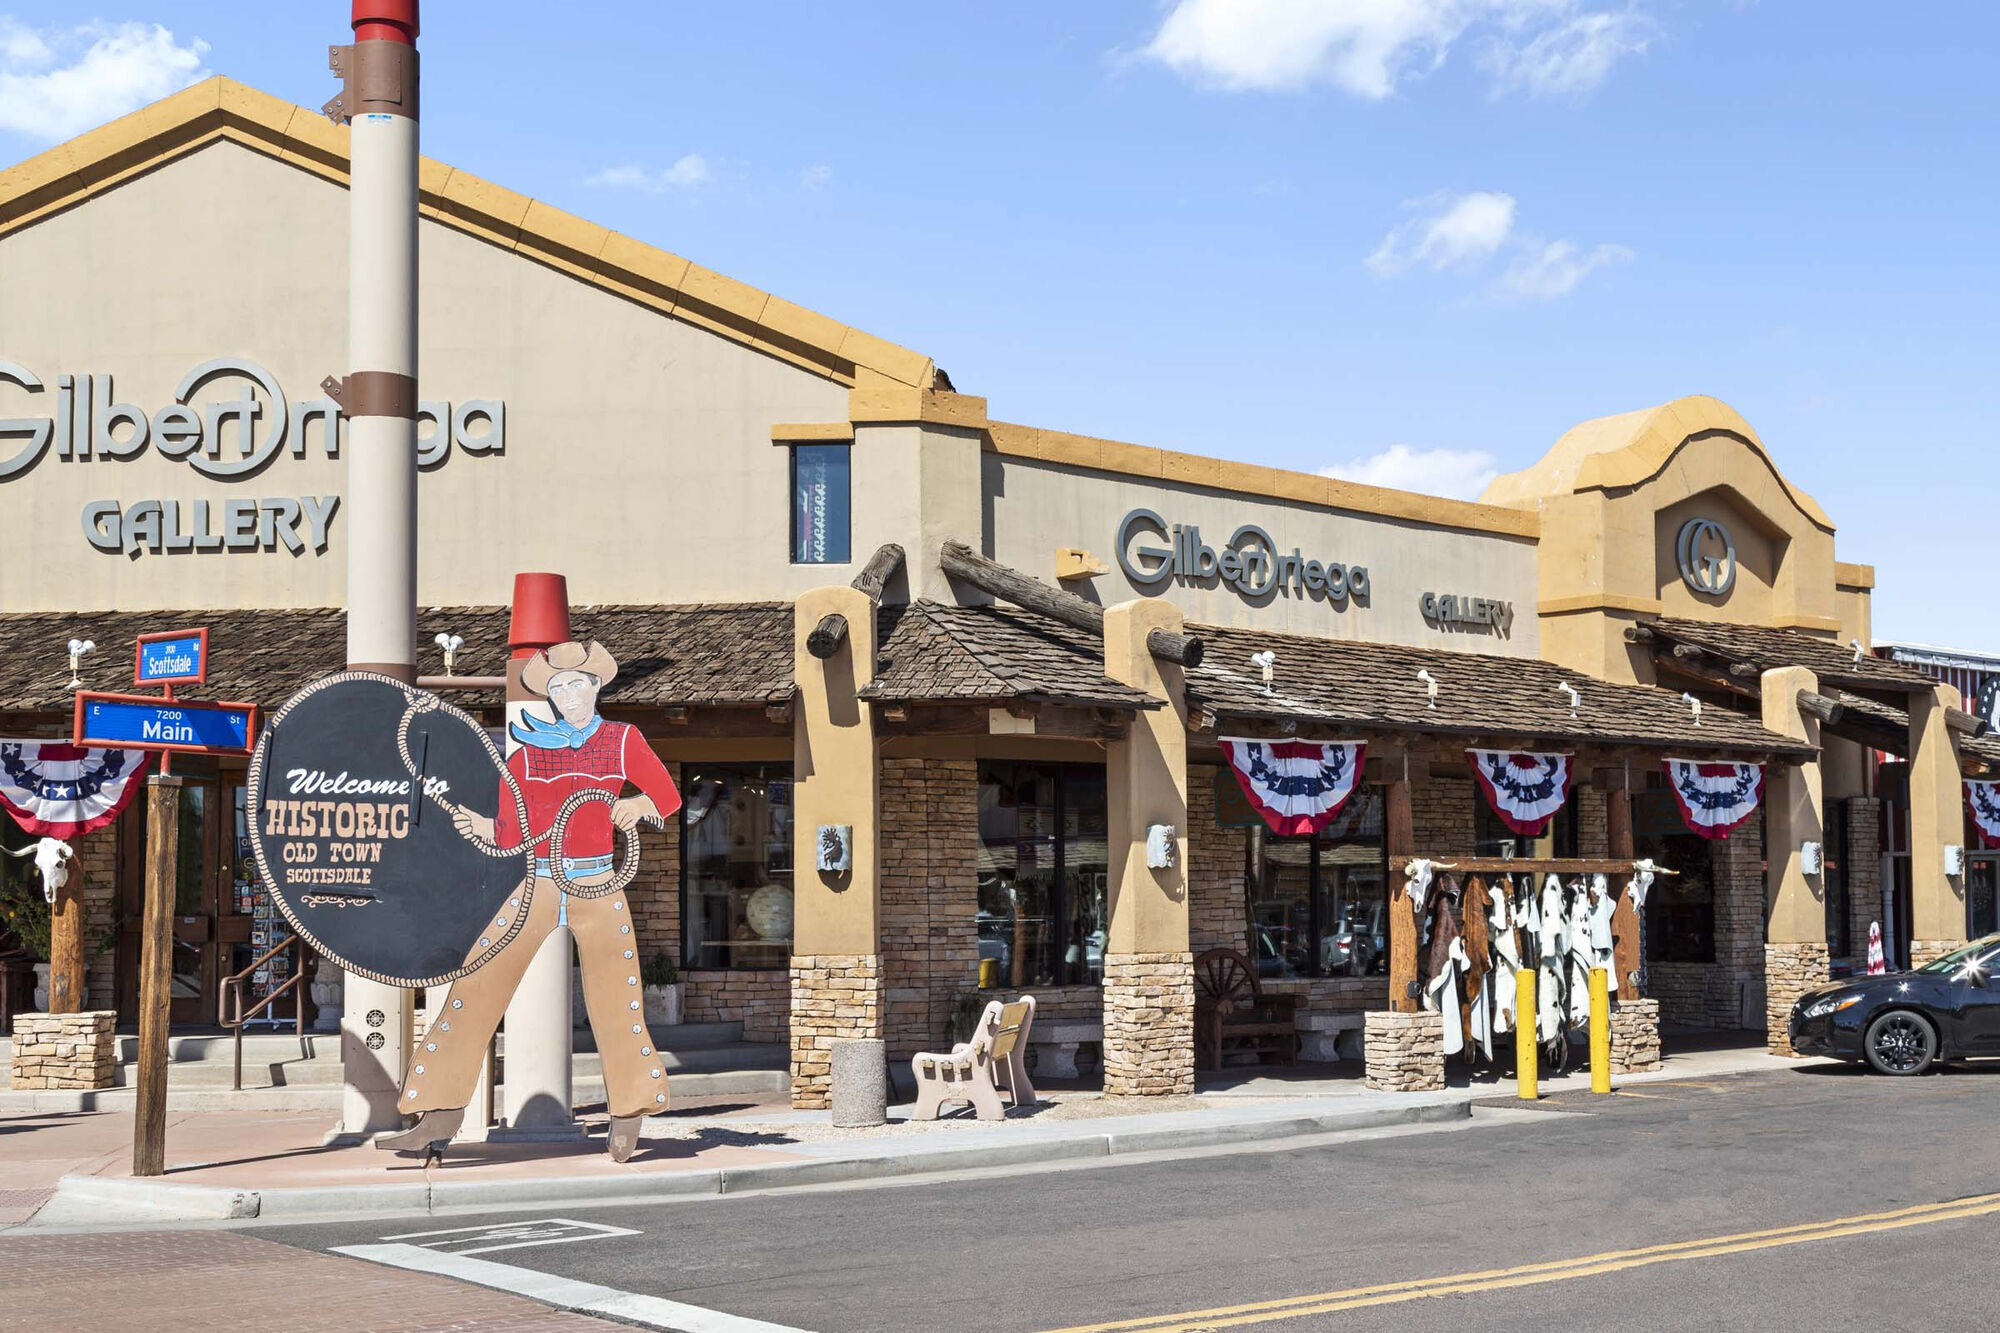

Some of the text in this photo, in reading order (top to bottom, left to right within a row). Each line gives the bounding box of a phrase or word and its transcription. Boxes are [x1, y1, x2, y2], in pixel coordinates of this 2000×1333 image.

[174, 357, 504, 476] Ortga
[81, 496, 341, 556] GALLERY
[1115, 507, 1369, 601] Gilbert Ortega
[1419, 591, 1513, 631] GALLERY
[148, 654, 192, 676] Scottsdale
[93, 706, 240, 725] E 7200 St
[142, 719, 193, 742] Main
[286, 768, 450, 796] Welcome to
[265, 799, 409, 840] HISTORIC
[282, 841, 382, 864] OLD TOWN
[286, 867, 372, 885] SCOTTSDALE
